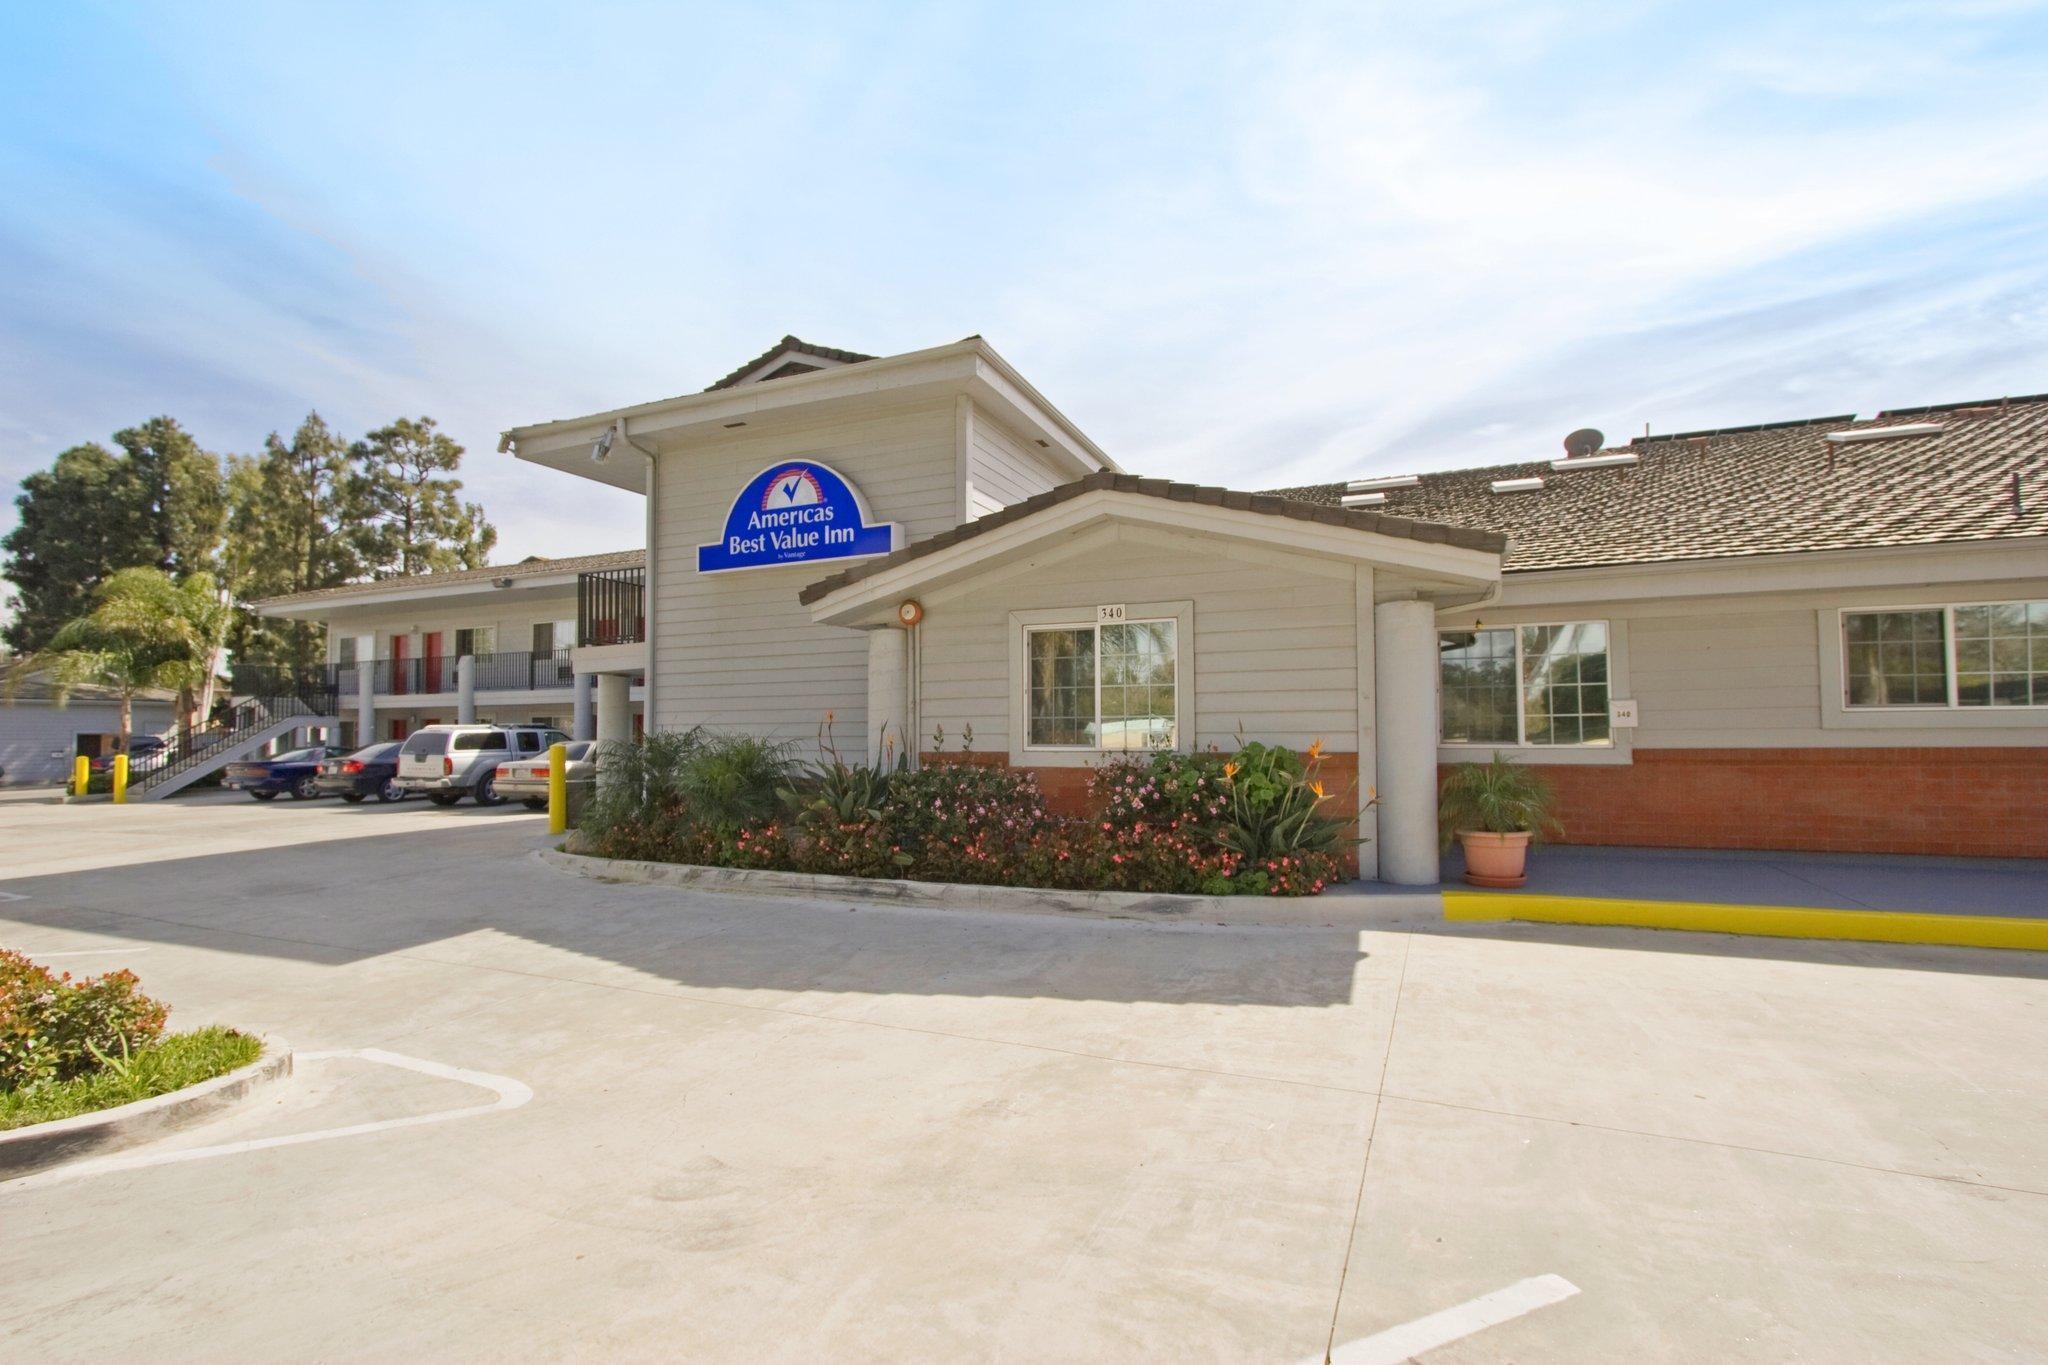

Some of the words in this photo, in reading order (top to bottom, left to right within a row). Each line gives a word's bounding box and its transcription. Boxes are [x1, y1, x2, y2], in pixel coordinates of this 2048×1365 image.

[748, 506, 834, 531] Americas
[730, 534, 766, 555] Best
[771, 530, 819, 550] Value
[824, 525, 855, 544] Inn
[1101, 607, 1123, 619] 340
